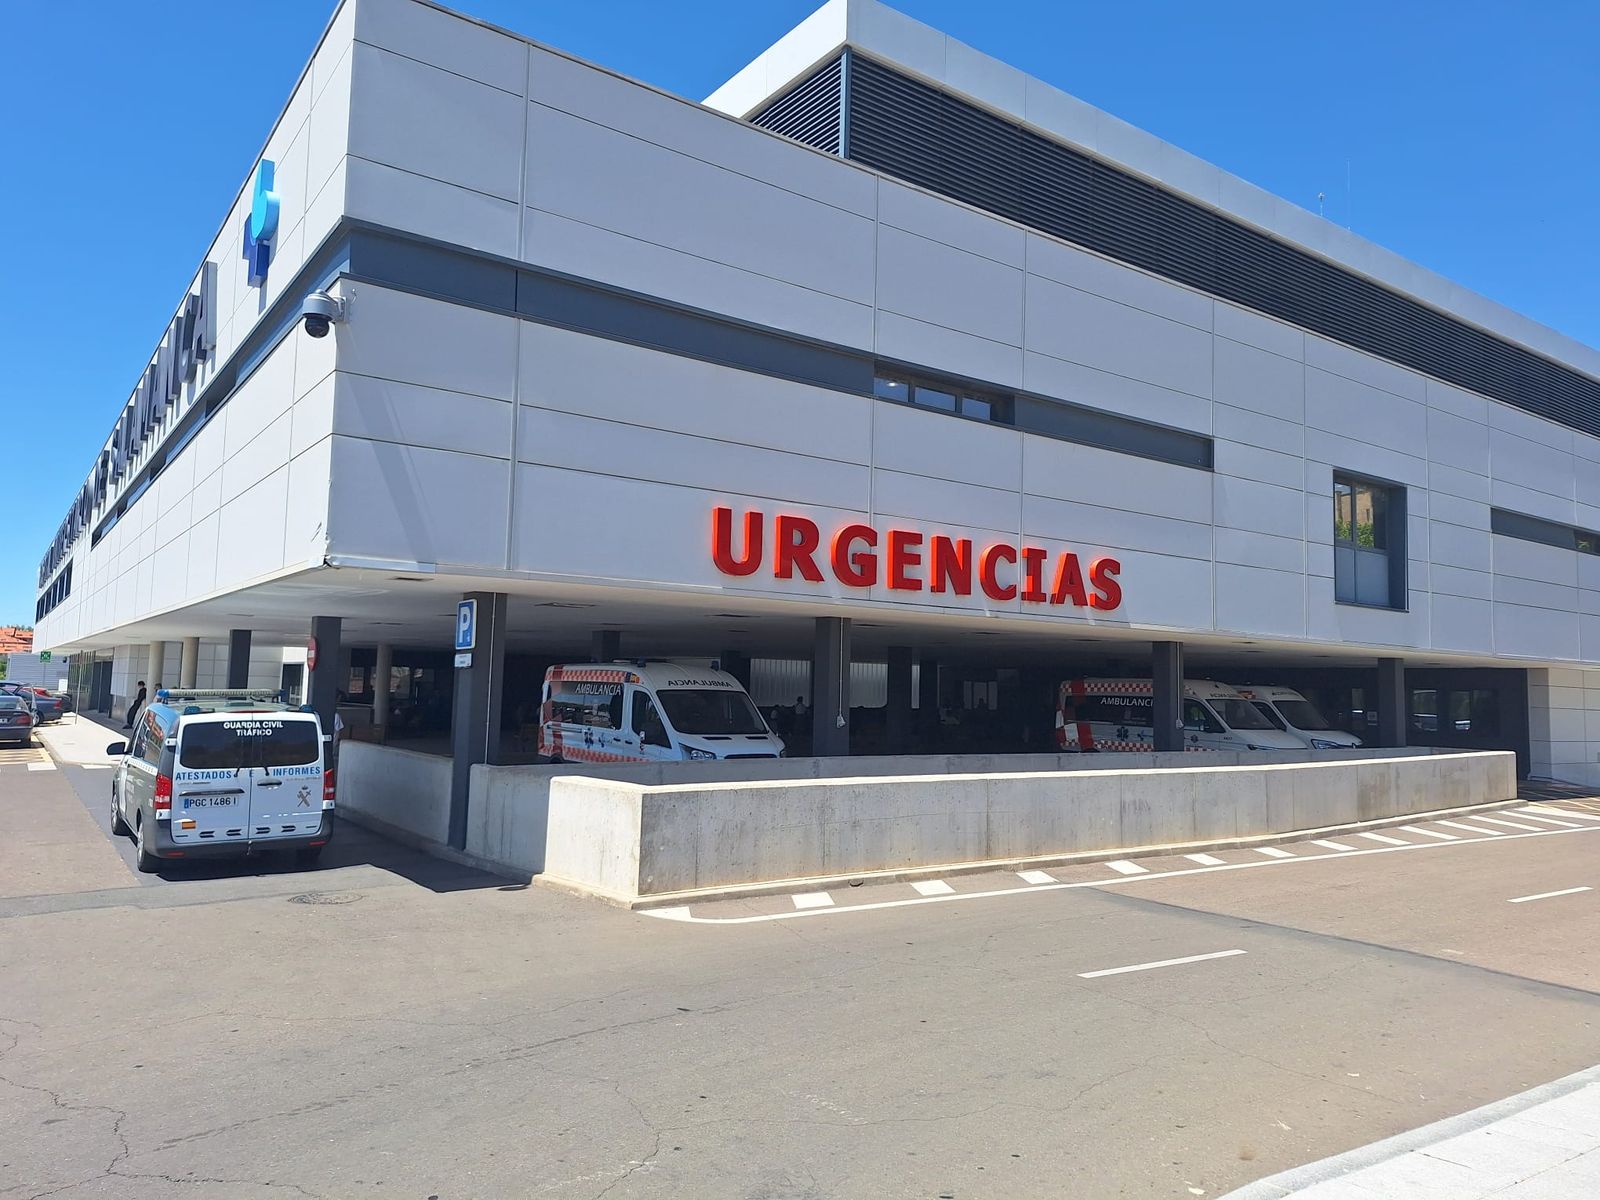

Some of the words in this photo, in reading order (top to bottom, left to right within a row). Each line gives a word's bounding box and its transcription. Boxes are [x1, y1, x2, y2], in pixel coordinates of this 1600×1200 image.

[711, 506, 1122, 611] URGENCIAS
[459, 606, 471, 643] P
[575, 683, 621, 696] AMBULANCIA
[1101, 697, 1153, 707] AMBULANCI
[223, 721, 261, 729] GUARDIA
[262, 720, 284, 728] CIVIL
[175, 770, 232, 780] ATESTADOS
[273, 766, 321, 776] INFORMES
[189, 799, 206, 808] PGC
[209, 797, 231, 806] 1486
